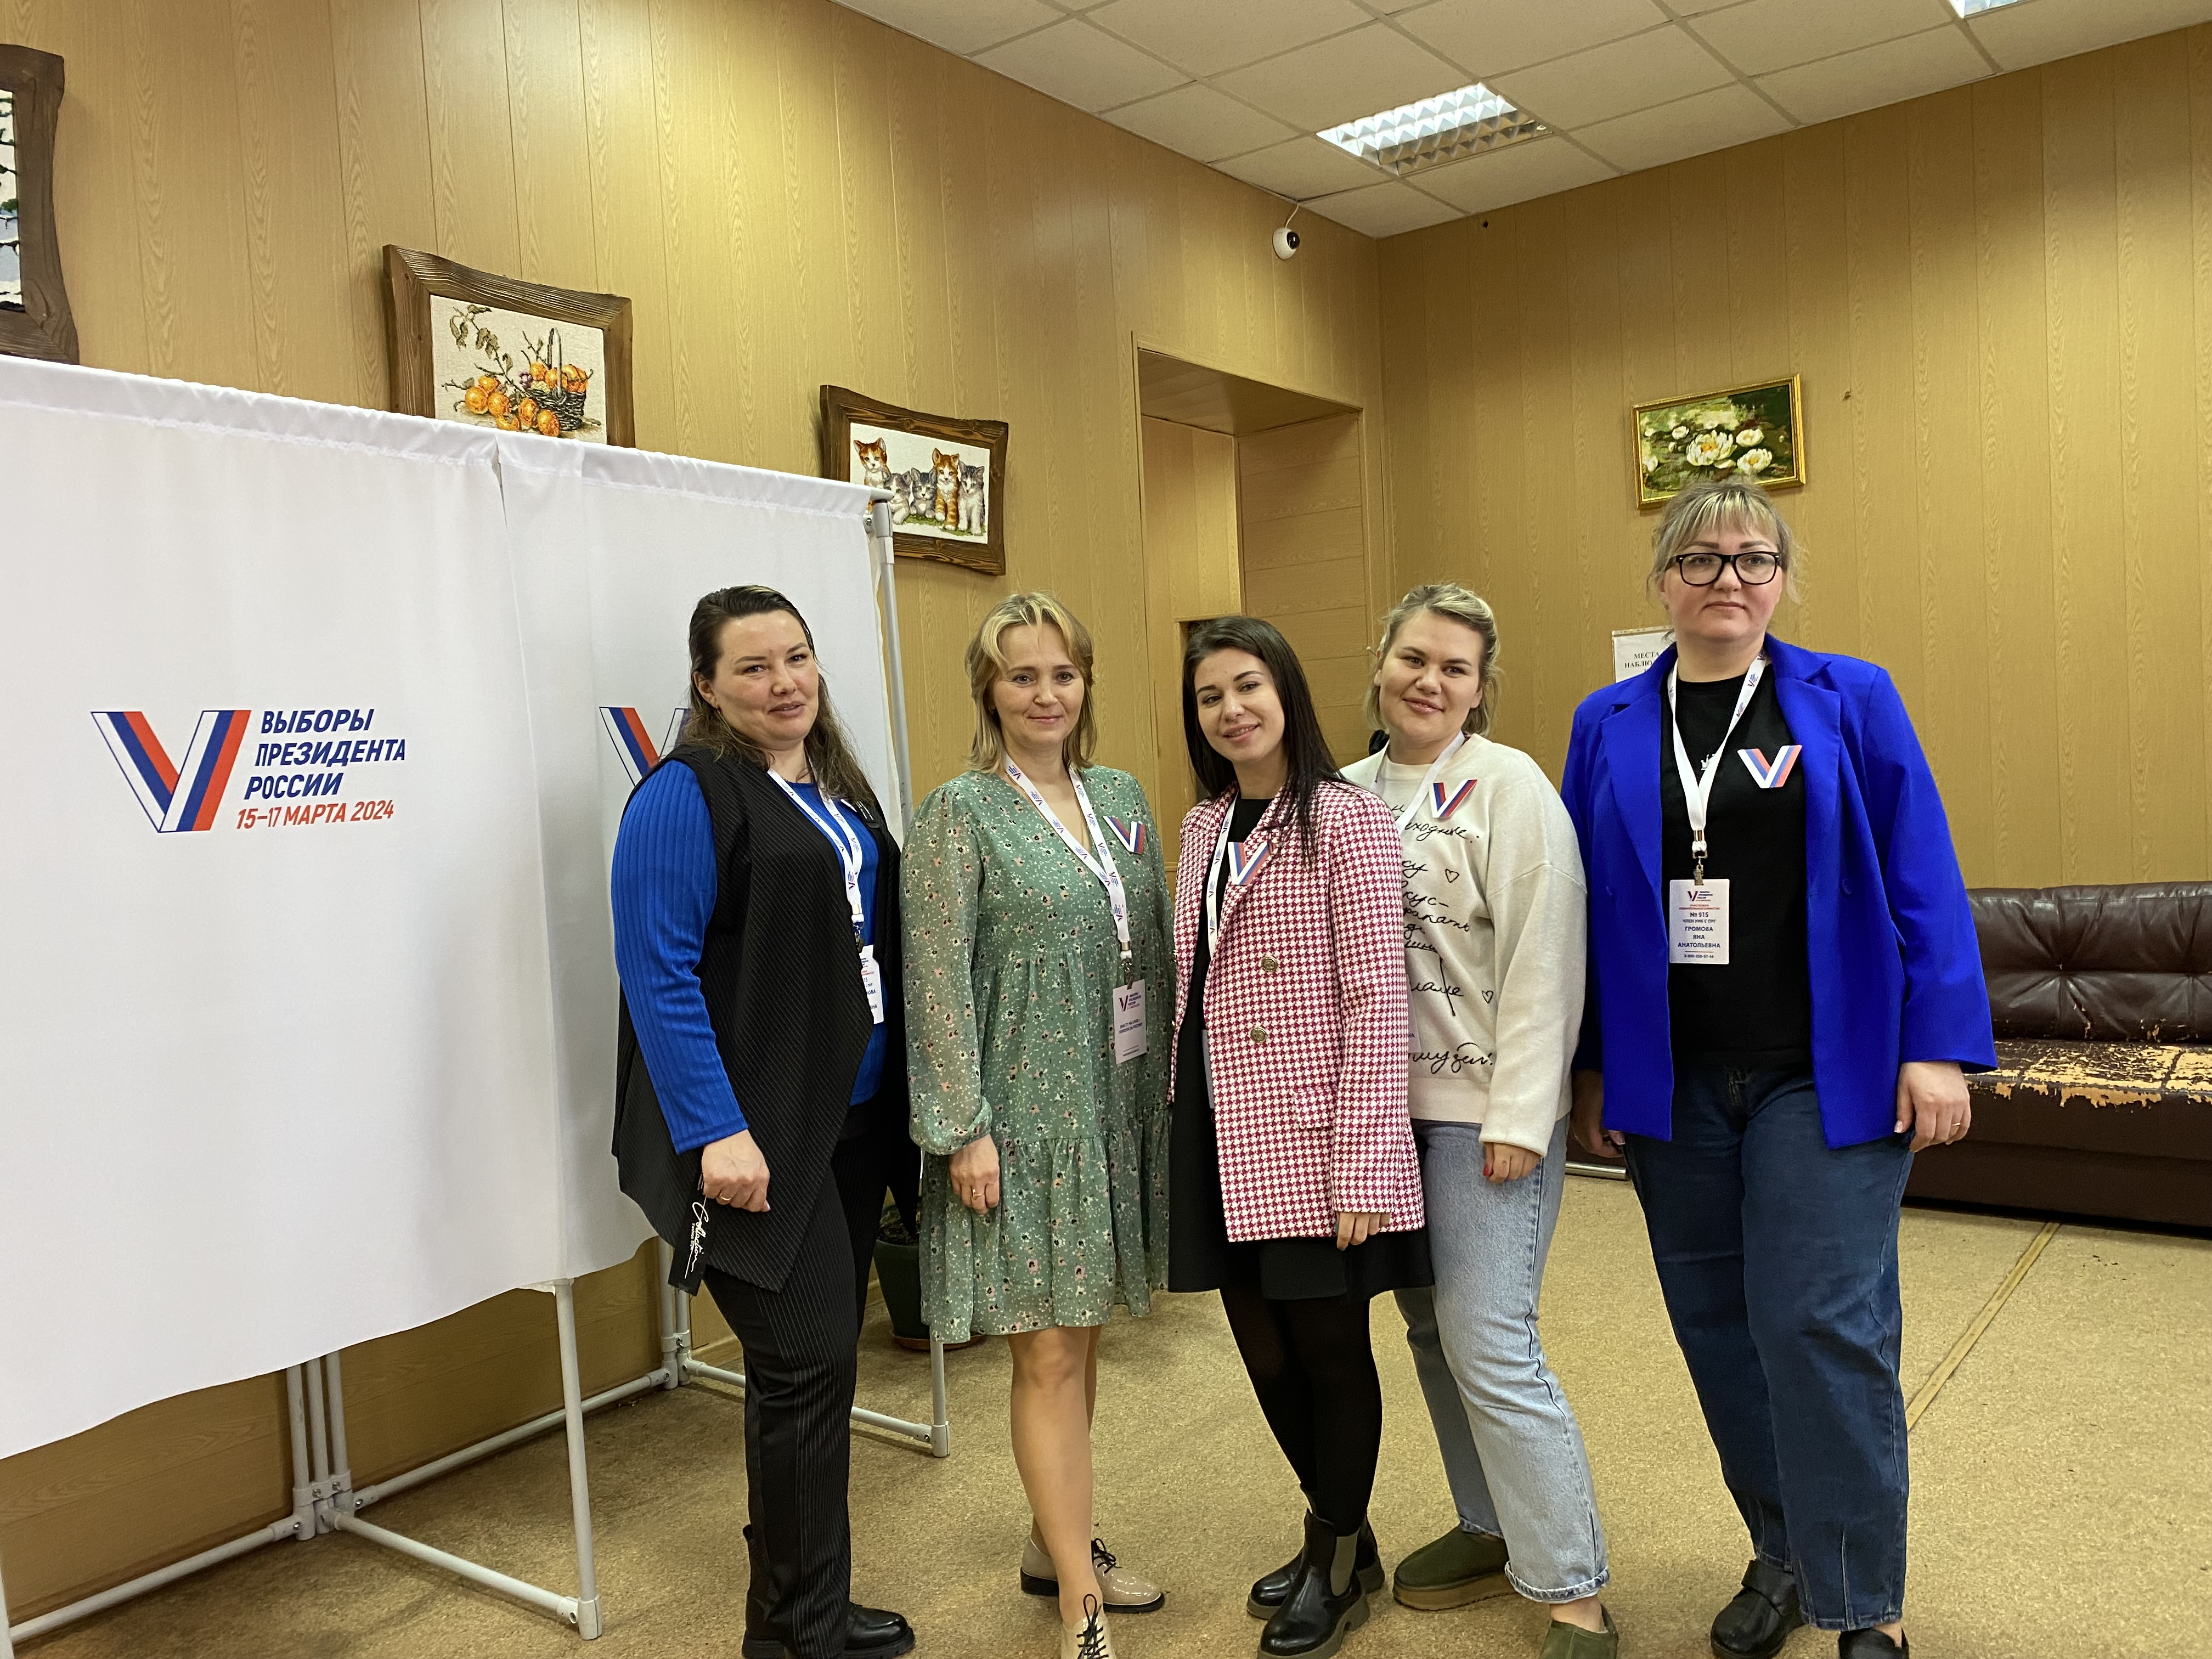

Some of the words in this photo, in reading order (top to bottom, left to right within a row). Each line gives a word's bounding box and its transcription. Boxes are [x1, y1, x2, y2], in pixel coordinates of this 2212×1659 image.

[1624, 659, 1655, 668] НАБЛЮ
[261, 709, 374, 734] ВЫБОРЫ
[255, 738, 405, 766] ПРЕЗИДЕНТА
[244, 772, 344, 800] РОССИИ
[283, 802, 347, 826] МАРТА
[351, 800, 394, 822] 2024
